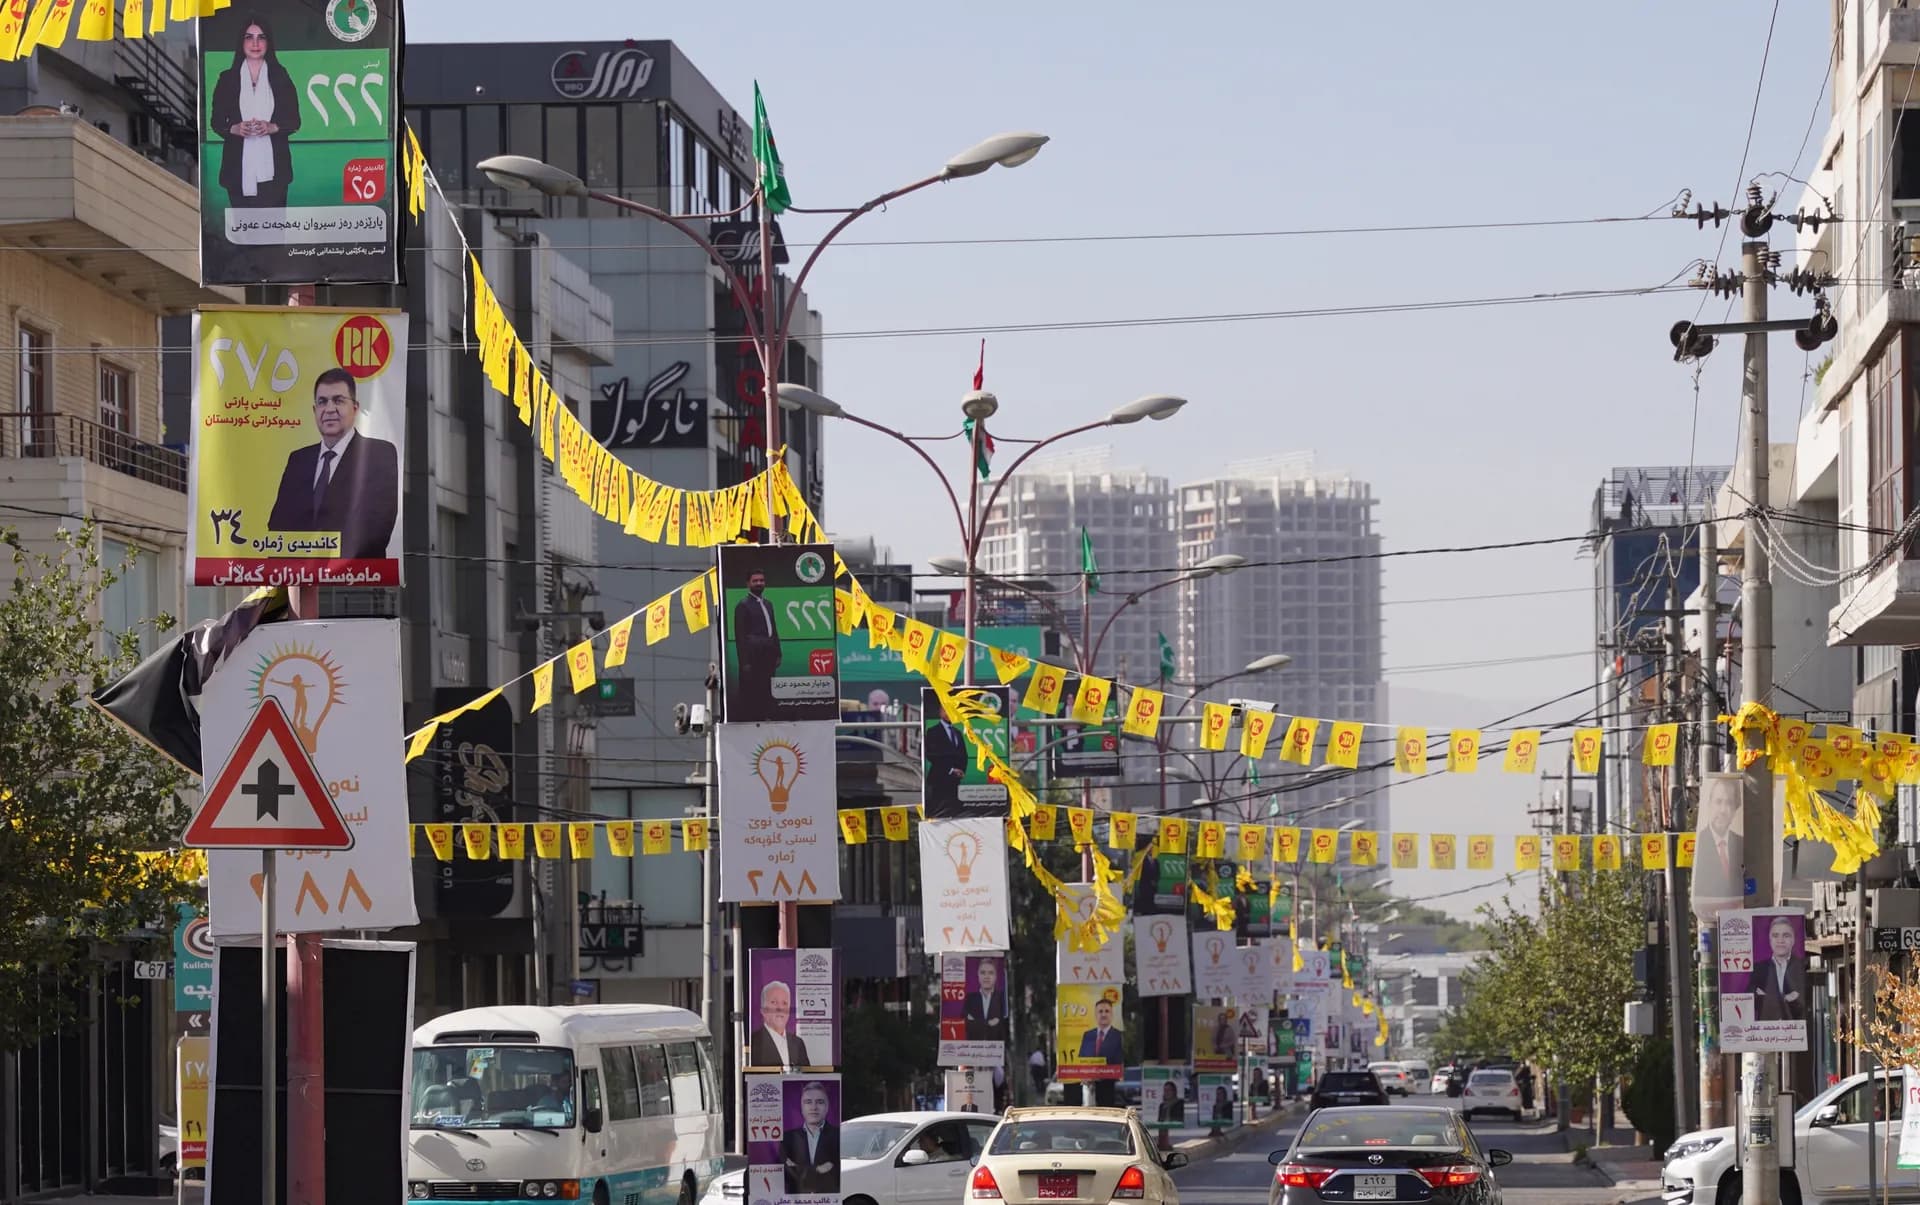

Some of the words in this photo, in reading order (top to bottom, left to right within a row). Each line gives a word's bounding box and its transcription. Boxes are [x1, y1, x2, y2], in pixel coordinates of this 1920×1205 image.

[306, 73, 383, 127] ٢٢٢
[351, 175, 376, 200] ٢٥
[304, 216, 336, 231] سیروان
[209, 337, 299, 393] ٢٧٥
[224, 397, 249, 411] پارتی
[251, 397, 281, 409] لیستی
[205, 414, 250, 428] کوردستان
[252, 416, 301, 428] دیموکراتی
[210, 508, 247, 545] ٣٤
[252, 536, 284, 551] ژمارە
[288, 536, 338, 551] کاندیدی
[269, 567, 314, 588] بارزان
[318, 566, 382, 585] مامۆستا
[786, 600, 832, 631] ٢٢٢
[776, 816, 813, 829] نەوەی
[785, 834, 817, 846] لیستی
[768, 850, 796, 865] ژمارە
[747, 869, 817, 897] ٢٨٨
[943, 925, 993, 945] ٢٨٨
[149, 962, 165, 979] 67
[1723, 958, 1752, 971] ٢٢٥
[1072, 966, 1112, 980] ٢٨٨
[751, 1126, 781, 1139] ٢٢٥
